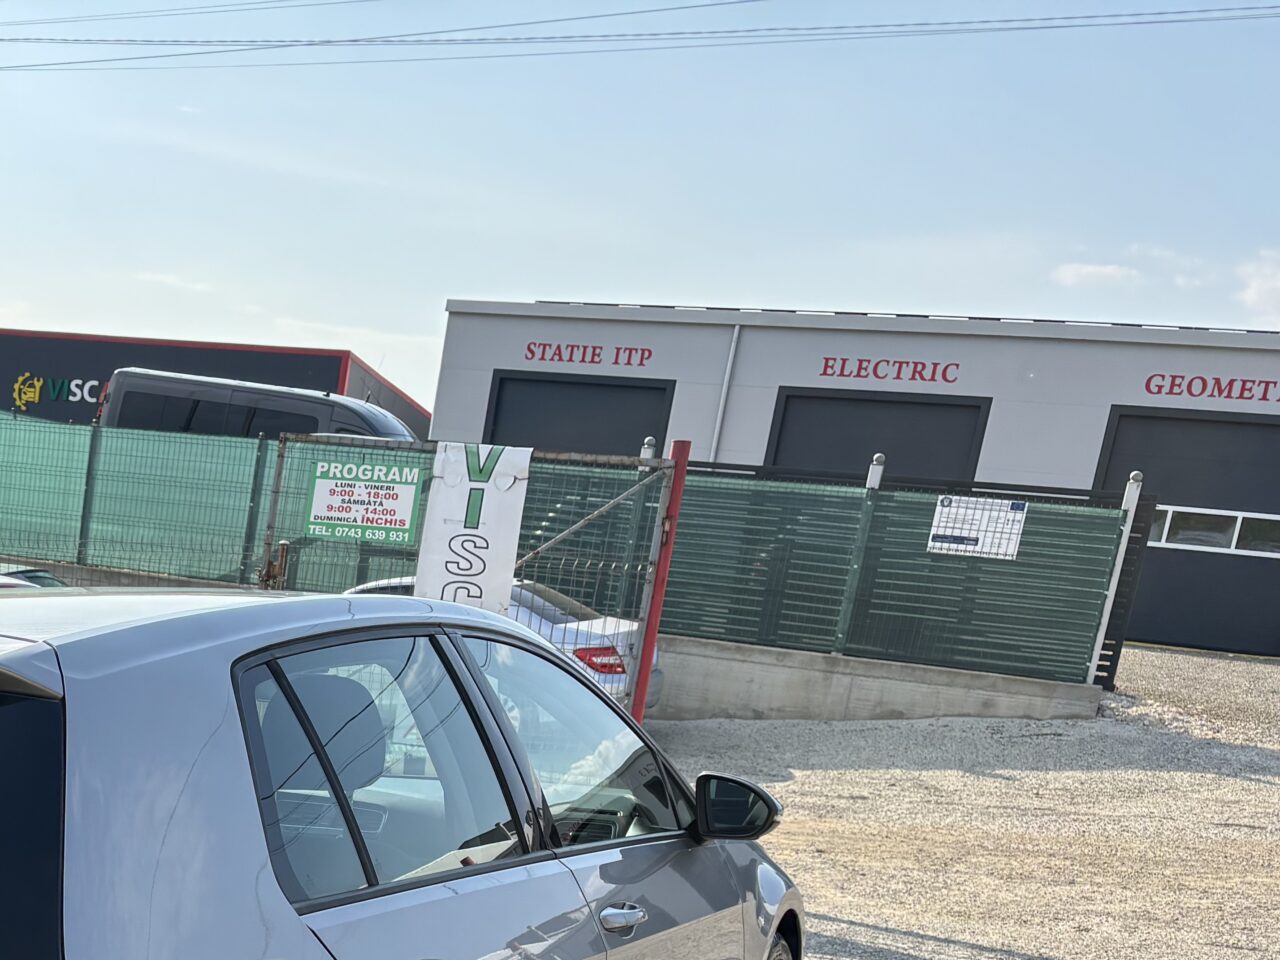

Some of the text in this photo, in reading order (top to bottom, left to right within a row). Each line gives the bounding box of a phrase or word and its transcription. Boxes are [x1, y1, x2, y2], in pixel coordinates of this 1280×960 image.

[524, 341, 653, 367] STATIE ITP
[819, 357, 960, 383] ELECTRIC
[1144, 373, 1280, 402] GEOMET
[316, 462, 419, 483] PROGRAM
[329, 488, 354, 498] 9:00
[366, 491, 399, 501] 18:00
[335, 482, 356, 490] LUNI
[364, 483, 395, 492] VINERI
[326, 504, 352, 513] 9:00
[363, 507, 396, 516] 14:00
[308, 525, 409, 542] TEL: 0743 639 931
